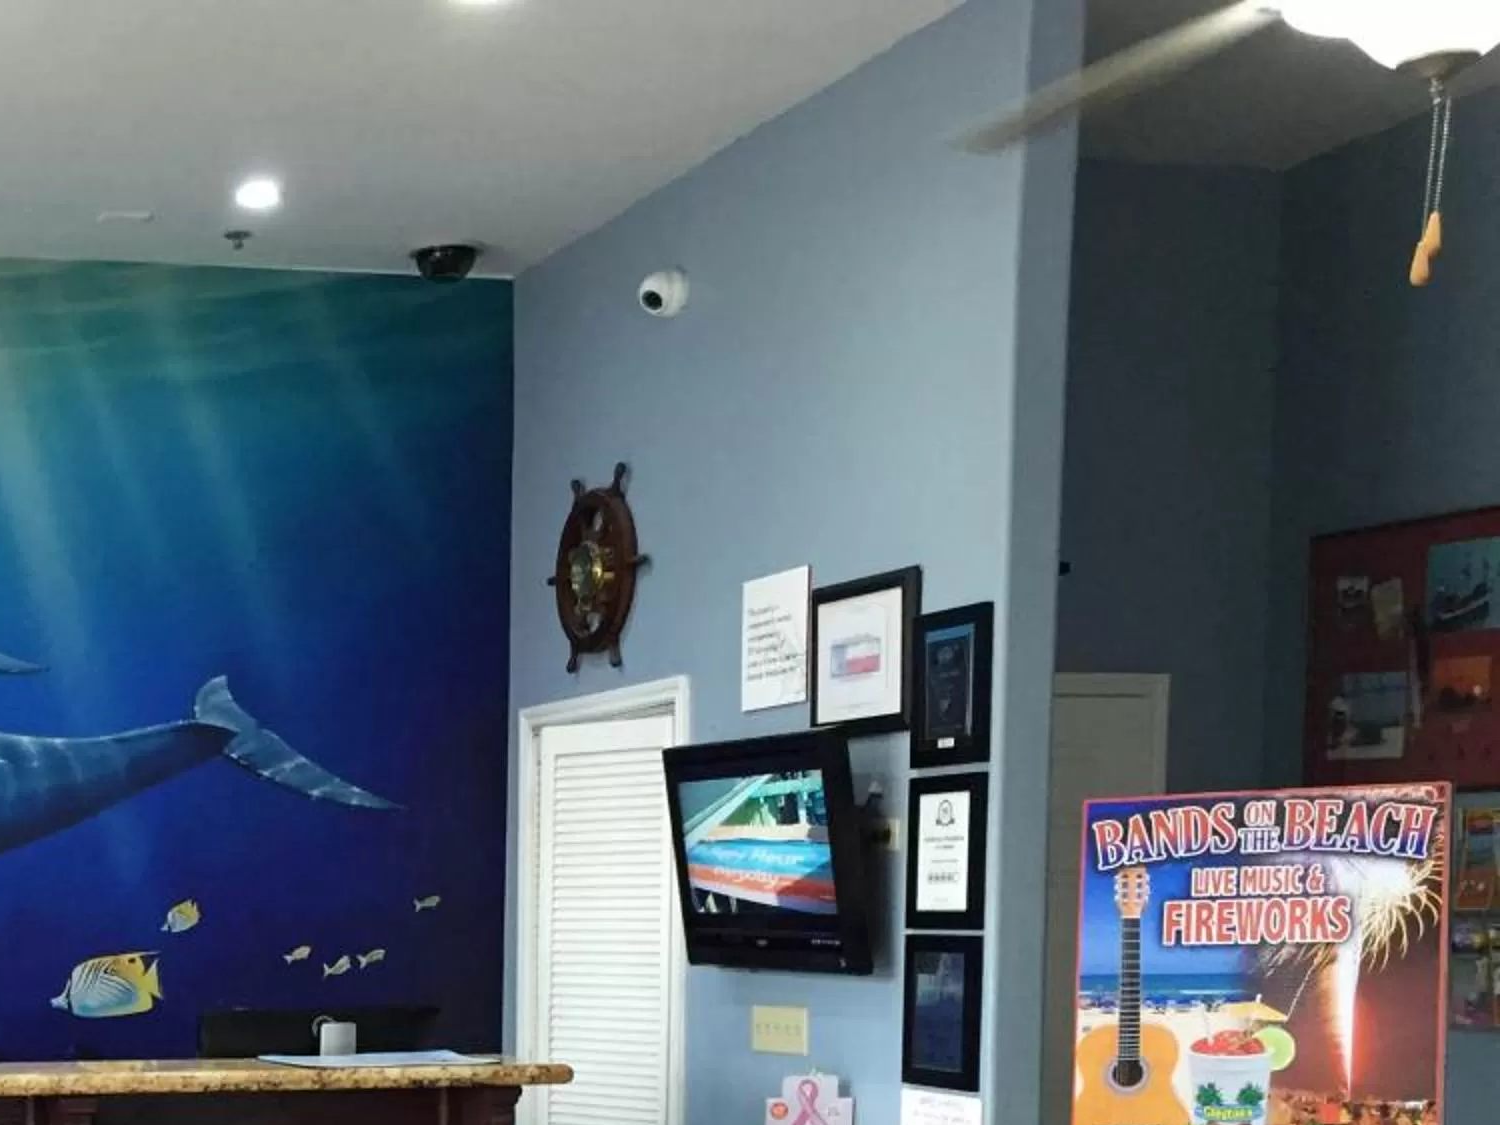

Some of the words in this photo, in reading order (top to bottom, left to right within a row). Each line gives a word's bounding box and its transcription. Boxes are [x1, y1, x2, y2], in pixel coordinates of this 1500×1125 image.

[1092, 803, 1238, 870] BANDS
[1243, 800, 1277, 827] ON
[1239, 827, 1281, 854] THE
[1283, 799, 1436, 860] BEACH
[1191, 865, 1239, 897] LIVE
[1240, 864, 1303, 896] MUSIC
[1305, 864, 1326, 895] &
[1163, 896, 1353, 946] FIREWORKS
